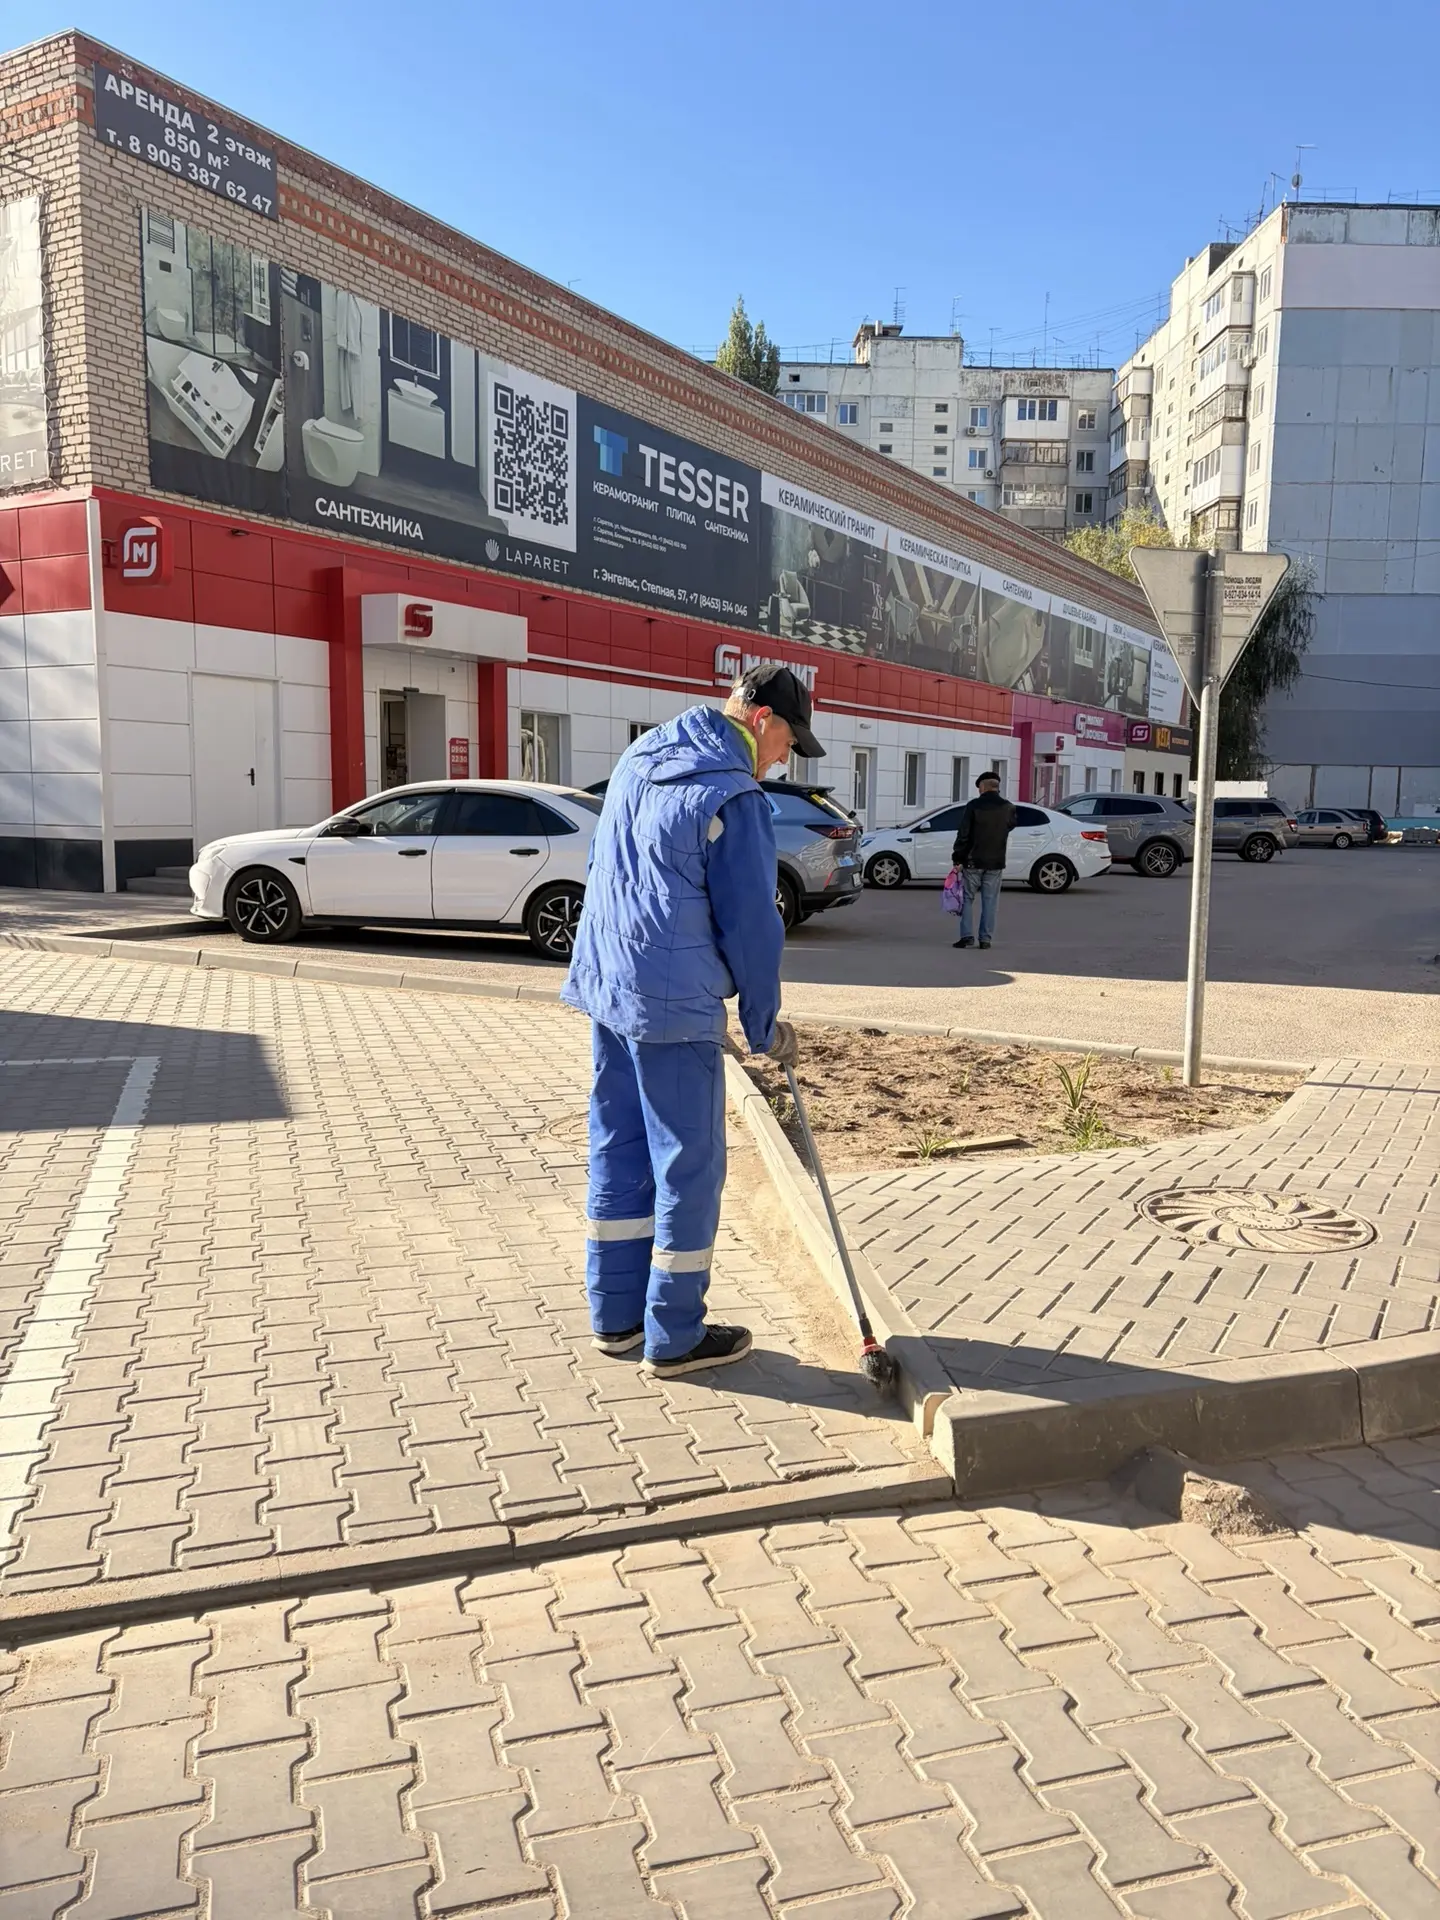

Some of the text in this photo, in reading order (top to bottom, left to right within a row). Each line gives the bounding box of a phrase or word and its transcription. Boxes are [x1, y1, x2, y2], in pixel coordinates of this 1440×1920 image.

[104, 73, 272, 171] АРЕНДА 2 этаж
[163, 127, 201, 159] 850
[106, 128, 272, 214] т. 8 905 387 62 47
[638, 443, 750, 523] TESSER
[315, 497, 424, 541] САНТЕХНИКА
[593, 480, 659, 513] КЕРАМОГРАНИТ
[666, 506, 696, 526] ПЛИТКА
[704, 519, 749, 544] САНТЕХНИКА
[778, 487, 875, 541] КЕРАМИЧЕСКИЙ ГРАНИТ
[505, 547, 570, 575] LAPARET
[900, 536, 972, 576] КЕРАМИЧЕСКАЯ ПЛИТКА
[593, 568, 748, 617] г. Энгельс, Степная, 57, +7 (8453) 514 046
[1002, 579, 1033, 601] САНТЕХНИКА
[743, 653, 818, 692] МИТ
